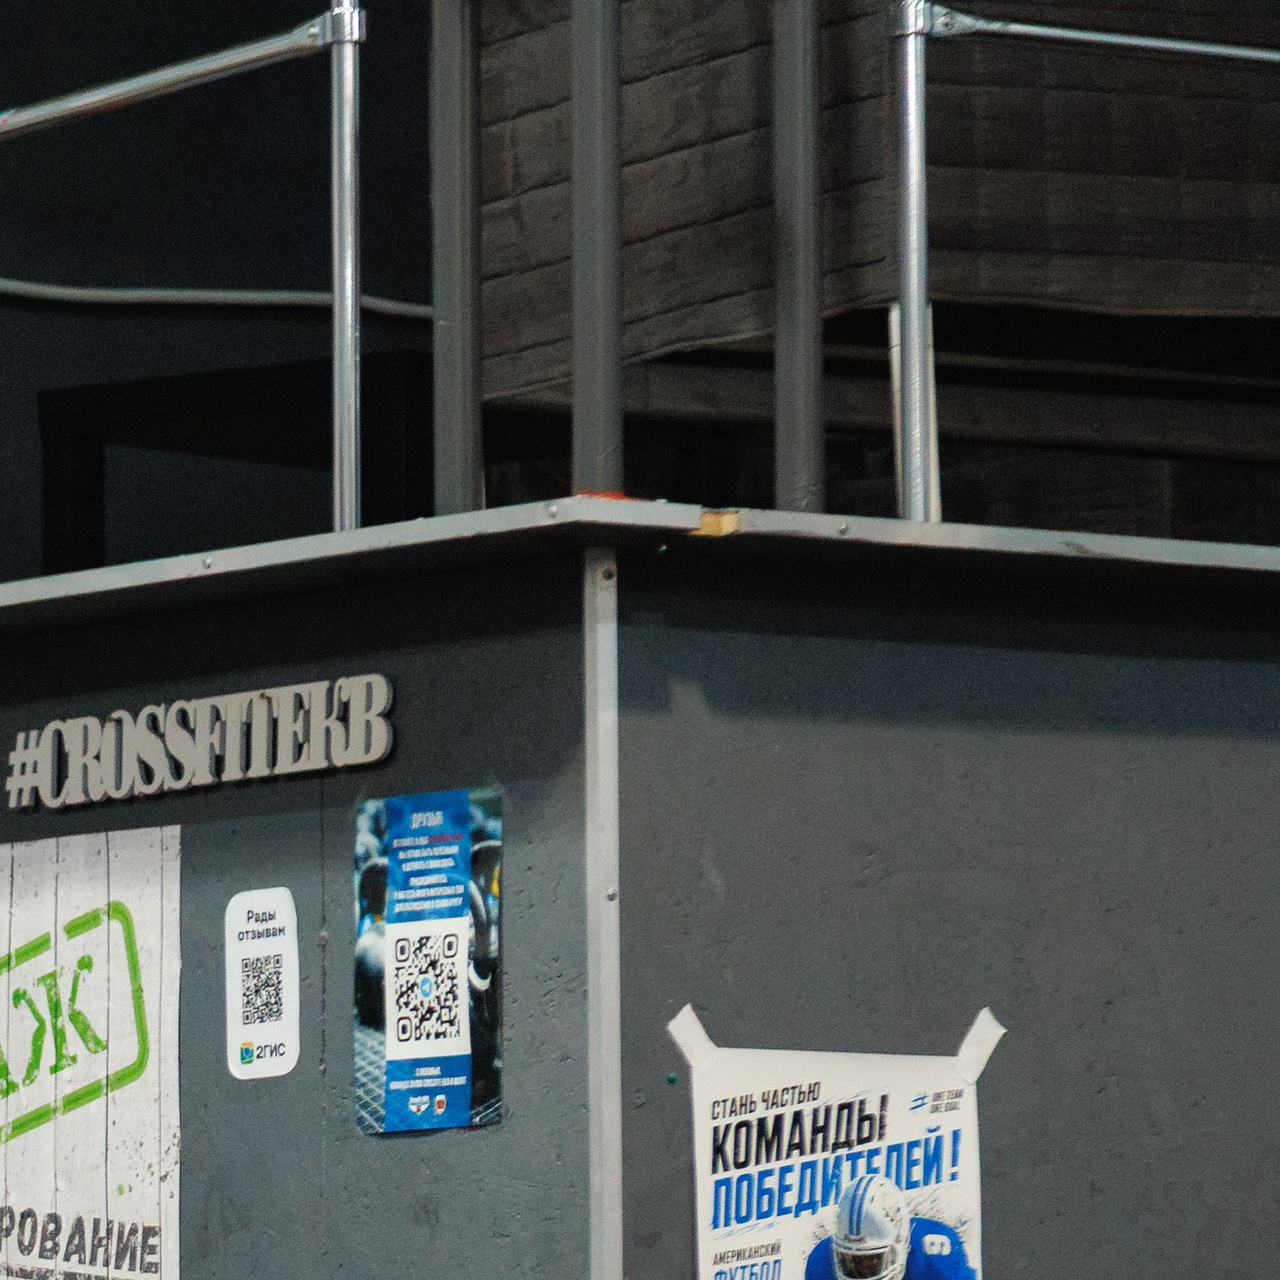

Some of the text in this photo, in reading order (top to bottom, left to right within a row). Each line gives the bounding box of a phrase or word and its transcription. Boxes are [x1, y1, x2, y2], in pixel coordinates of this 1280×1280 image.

[247, 910, 276, 924] Рады
[238, 925, 286, 941] отзывам
[256, 1043, 286, 1059] 2ГИС
[712, 1081, 821, 1120] СТАНЬ ЧАСТЬЮ
[711, 1094, 890, 1175] КОМАНДЫ
[713, 1239, 782, 1266] АМЕРИКАНСКИЙ
